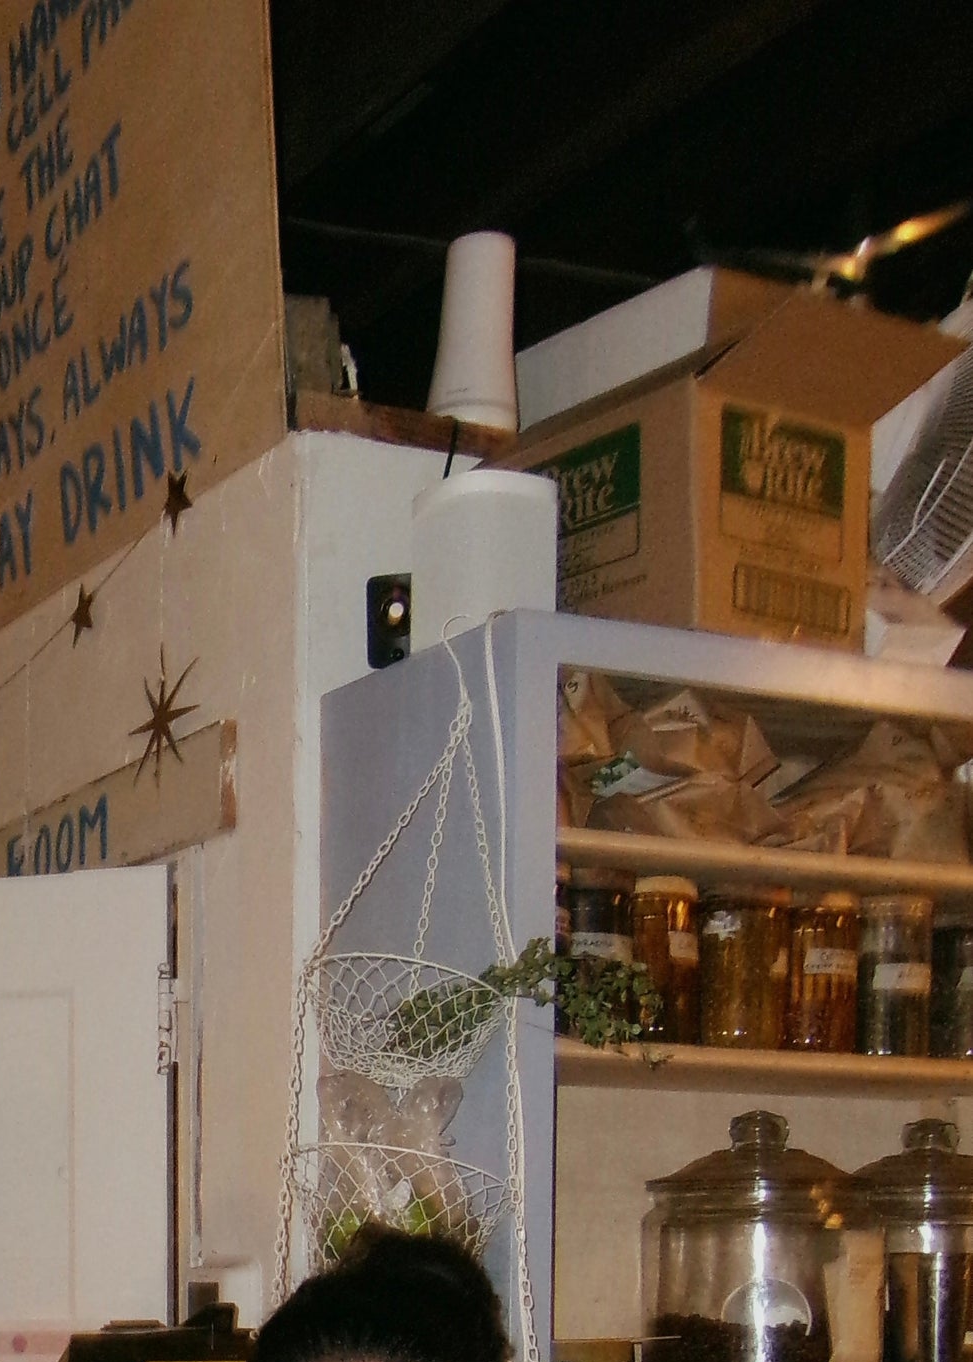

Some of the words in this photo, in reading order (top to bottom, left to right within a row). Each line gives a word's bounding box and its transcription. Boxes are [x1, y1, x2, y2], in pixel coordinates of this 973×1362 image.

[6, 47, 72, 154] CELL
[20, 106, 74, 213] THE
[44, 118, 122, 262] CHAT
[62, 259, 194, 424] ALWAYS
[59, 375, 202, 545] DRINK
